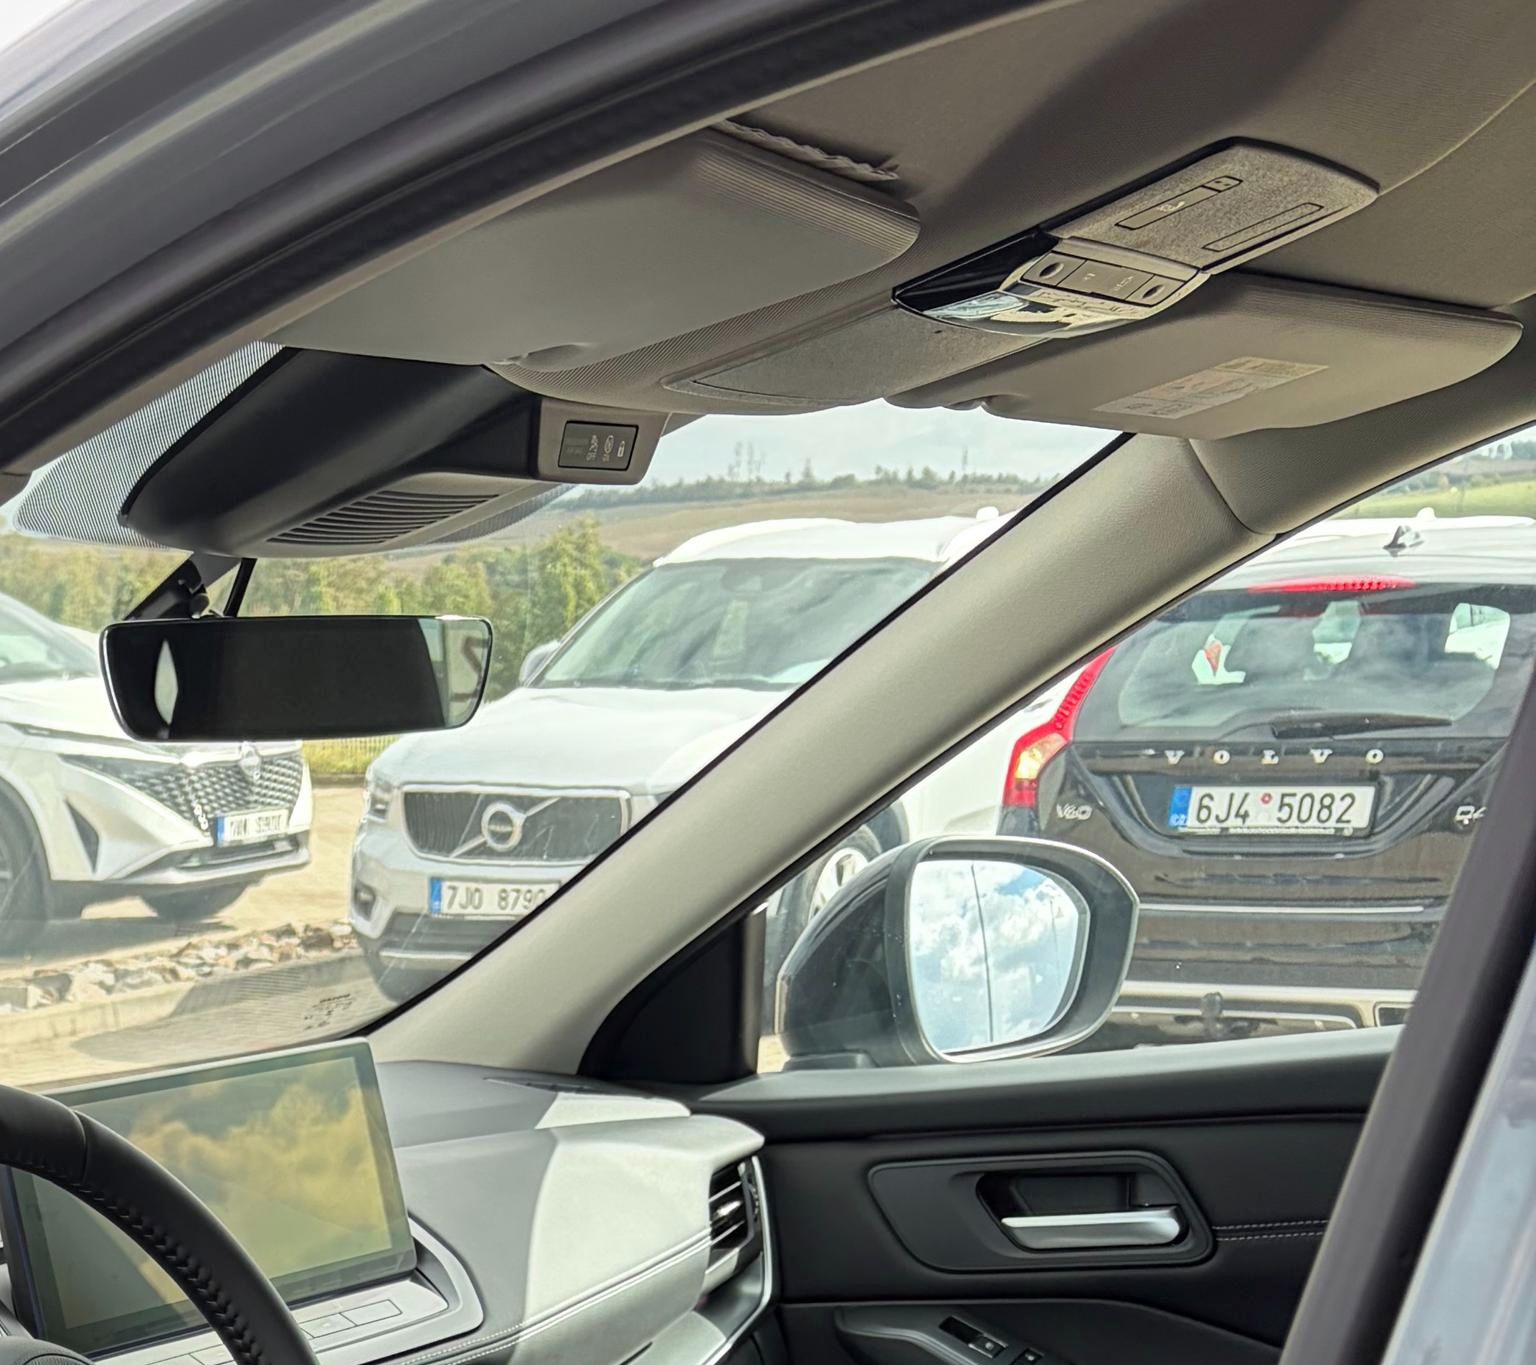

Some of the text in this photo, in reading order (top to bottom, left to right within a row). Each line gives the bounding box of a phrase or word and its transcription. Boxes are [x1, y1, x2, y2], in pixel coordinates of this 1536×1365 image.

[1165, 748, 1385, 766] VOLVO
[1196, 792, 1251, 824] 6J4
[1276, 792, 1356, 824] 5082
[446, 885, 483, 910] 7J0
